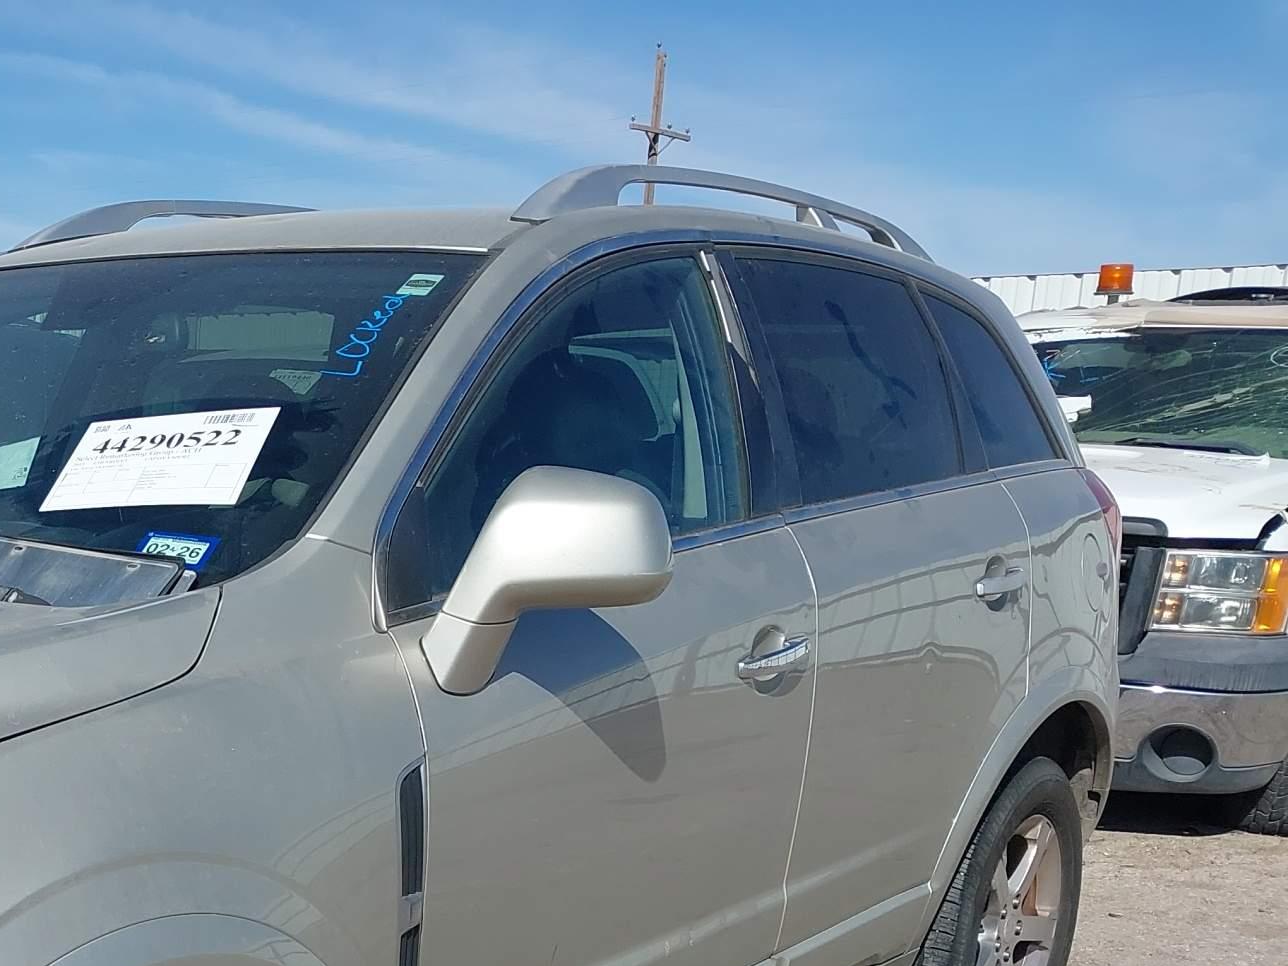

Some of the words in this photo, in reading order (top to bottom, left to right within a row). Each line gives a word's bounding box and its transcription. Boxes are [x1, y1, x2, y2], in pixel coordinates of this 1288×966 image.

[92, 429, 242, 454] 44290522
[146, 543, 170, 555] 02
[176, 546, 202, 559] 26
